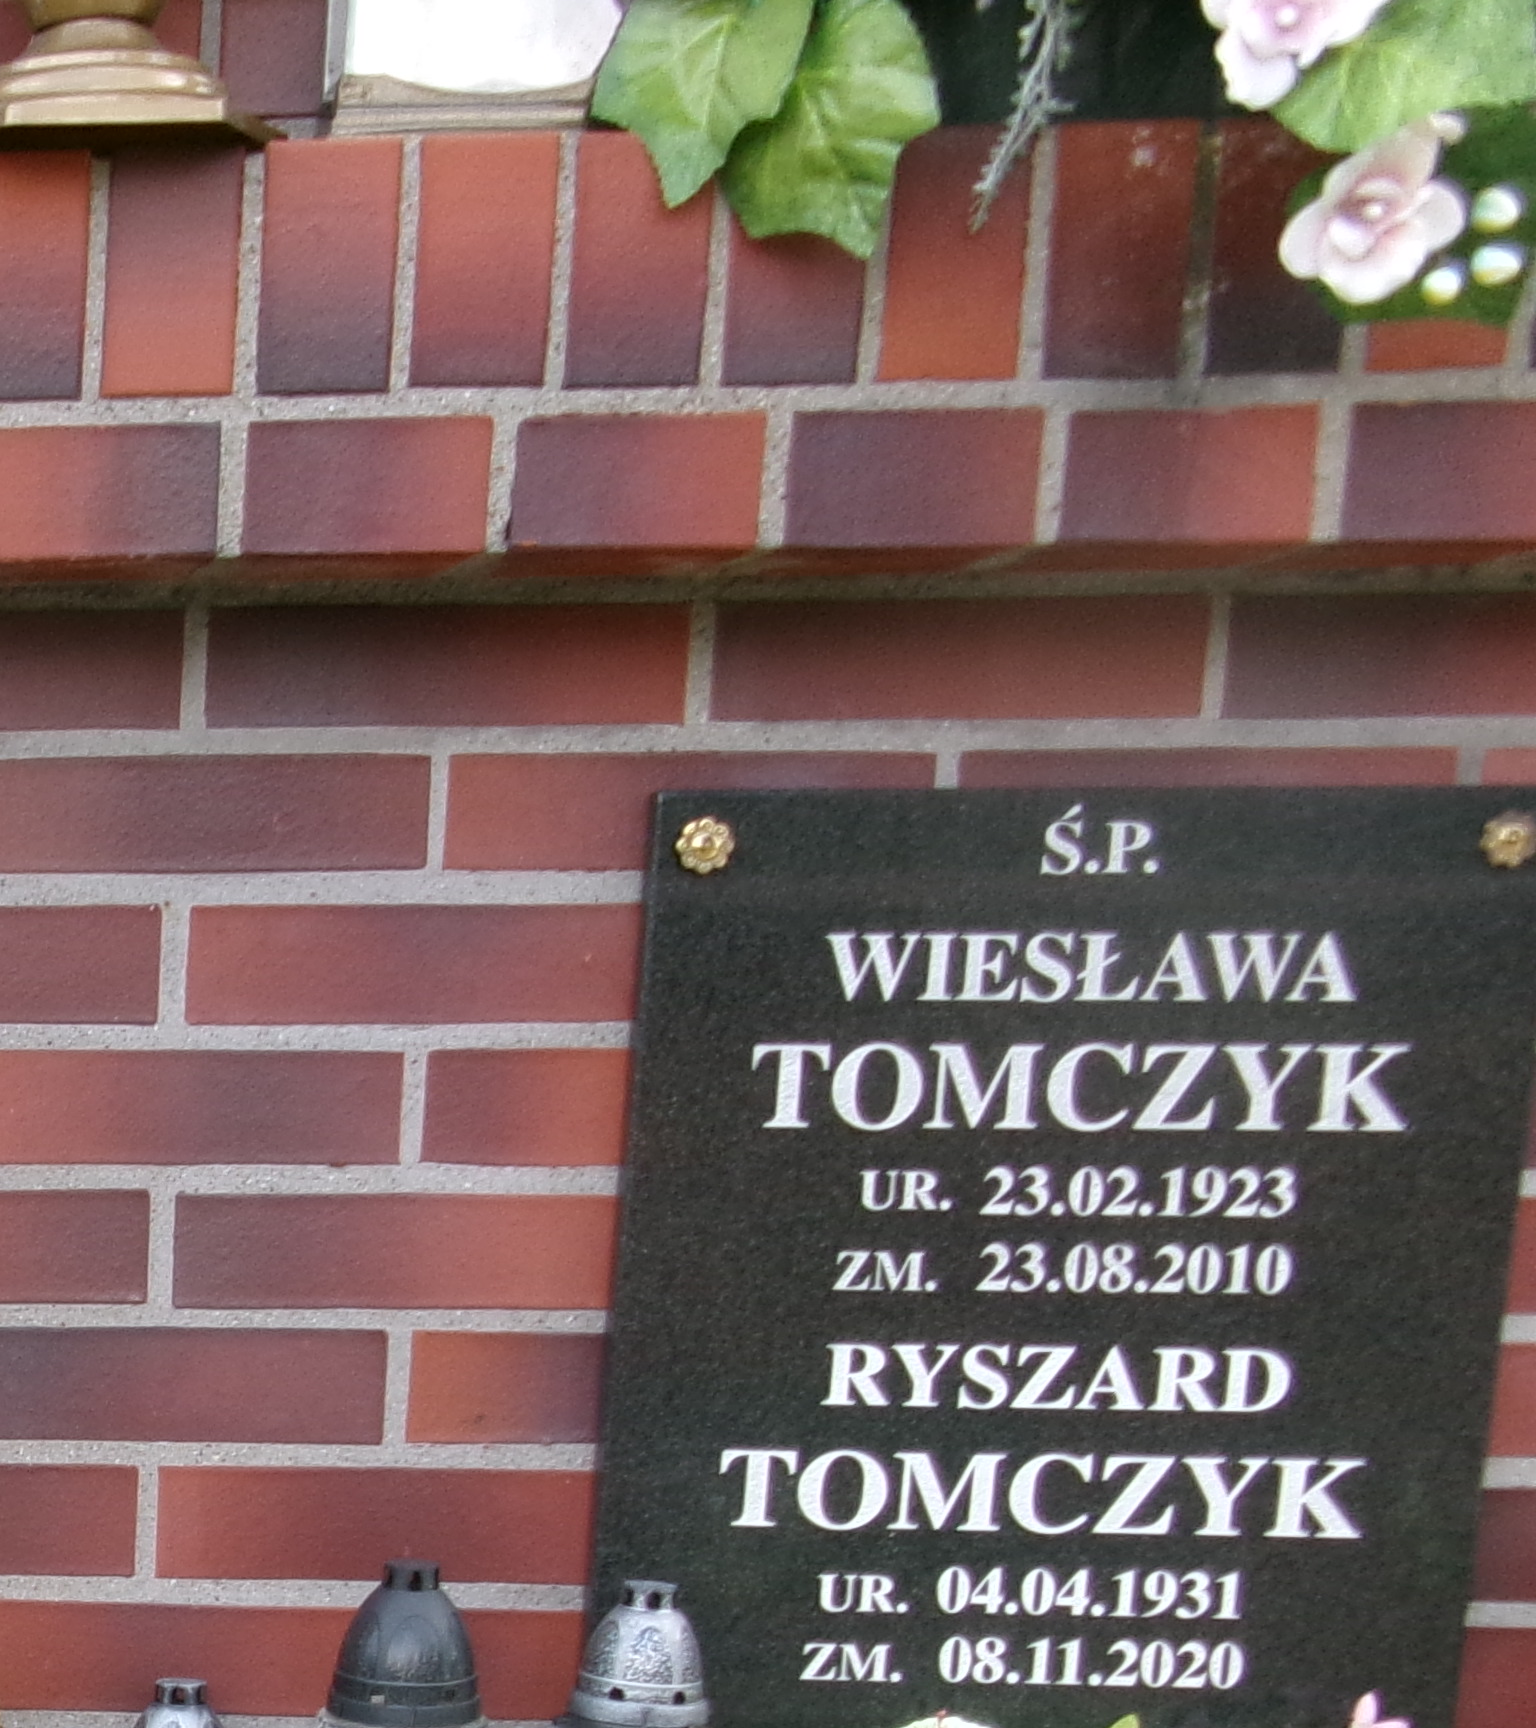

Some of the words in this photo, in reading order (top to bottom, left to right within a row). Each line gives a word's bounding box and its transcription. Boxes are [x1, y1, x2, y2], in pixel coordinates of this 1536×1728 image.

[825, 928, 1359, 1005] WIESŁAWA
[751, 1040, 1412, 1134] TOMCZYK
[859, 1168, 954, 1213] UR.
[978, 1165, 1298, 1220] 23.02.1923
[833, 1248, 939, 1295] ZM.
[975, 1242, 1294, 1297] 23.08.2010
[820, 1342, 1293, 1414] RYSZARD
[718, 1446, 1367, 1541] TOMCZYK
[818, 1573, 911, 1615] UR.
[935, 1565, 1243, 1622] 04.04.1931
[799, 1641, 904, 1686] ZM.
[937, 1636, 1246, 1691] 08.11.2020
